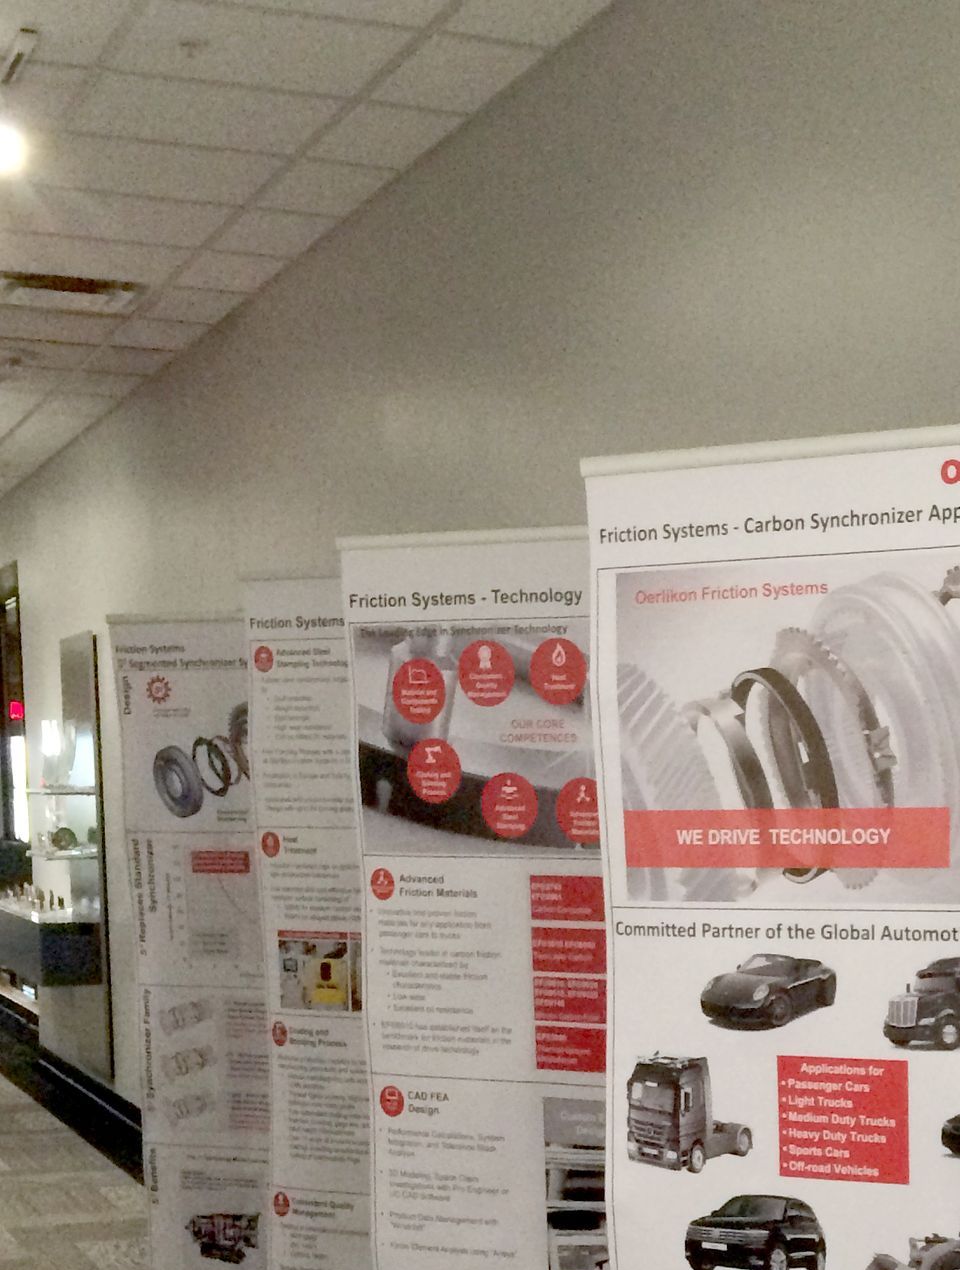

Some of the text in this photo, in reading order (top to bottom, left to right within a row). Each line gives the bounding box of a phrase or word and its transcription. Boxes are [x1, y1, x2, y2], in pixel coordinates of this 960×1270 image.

[600, 526, 657, 544] Friction
[663, 523, 728, 542] Systems
[744, 515, 804, 533] Carbon
[810, 507, 923, 532] Synchronizer
[349, 588, 582, 610] Friction Systems Technology
[635, 580, 829, 605] Oerlikon Friction Systems
[250, 616, 345, 630] Friction Systems
[677, 828, 890, 844] WE DRIVE TECHNOLOGY
[615, 920, 697, 940] Committed
[702, 923, 760, 939] Partner
[766, 923, 782, 939] of
[787, 924, 815, 939] the
[821, 924, 875, 940] Global
[801, 1063, 884, 1075] Applications for
[787, 1079, 870, 1093] Passenger Cars
[789, 1095, 853, 1108] Light Trucks
[788, 1112, 896, 1127] Medium Duty Trucks
[789, 1128, 886, 1143] Heavy Duty Trucks
[789, 1144, 849, 1158] Sports Cars
[789, 1161, 879, 1176] Off-road Vehicles
